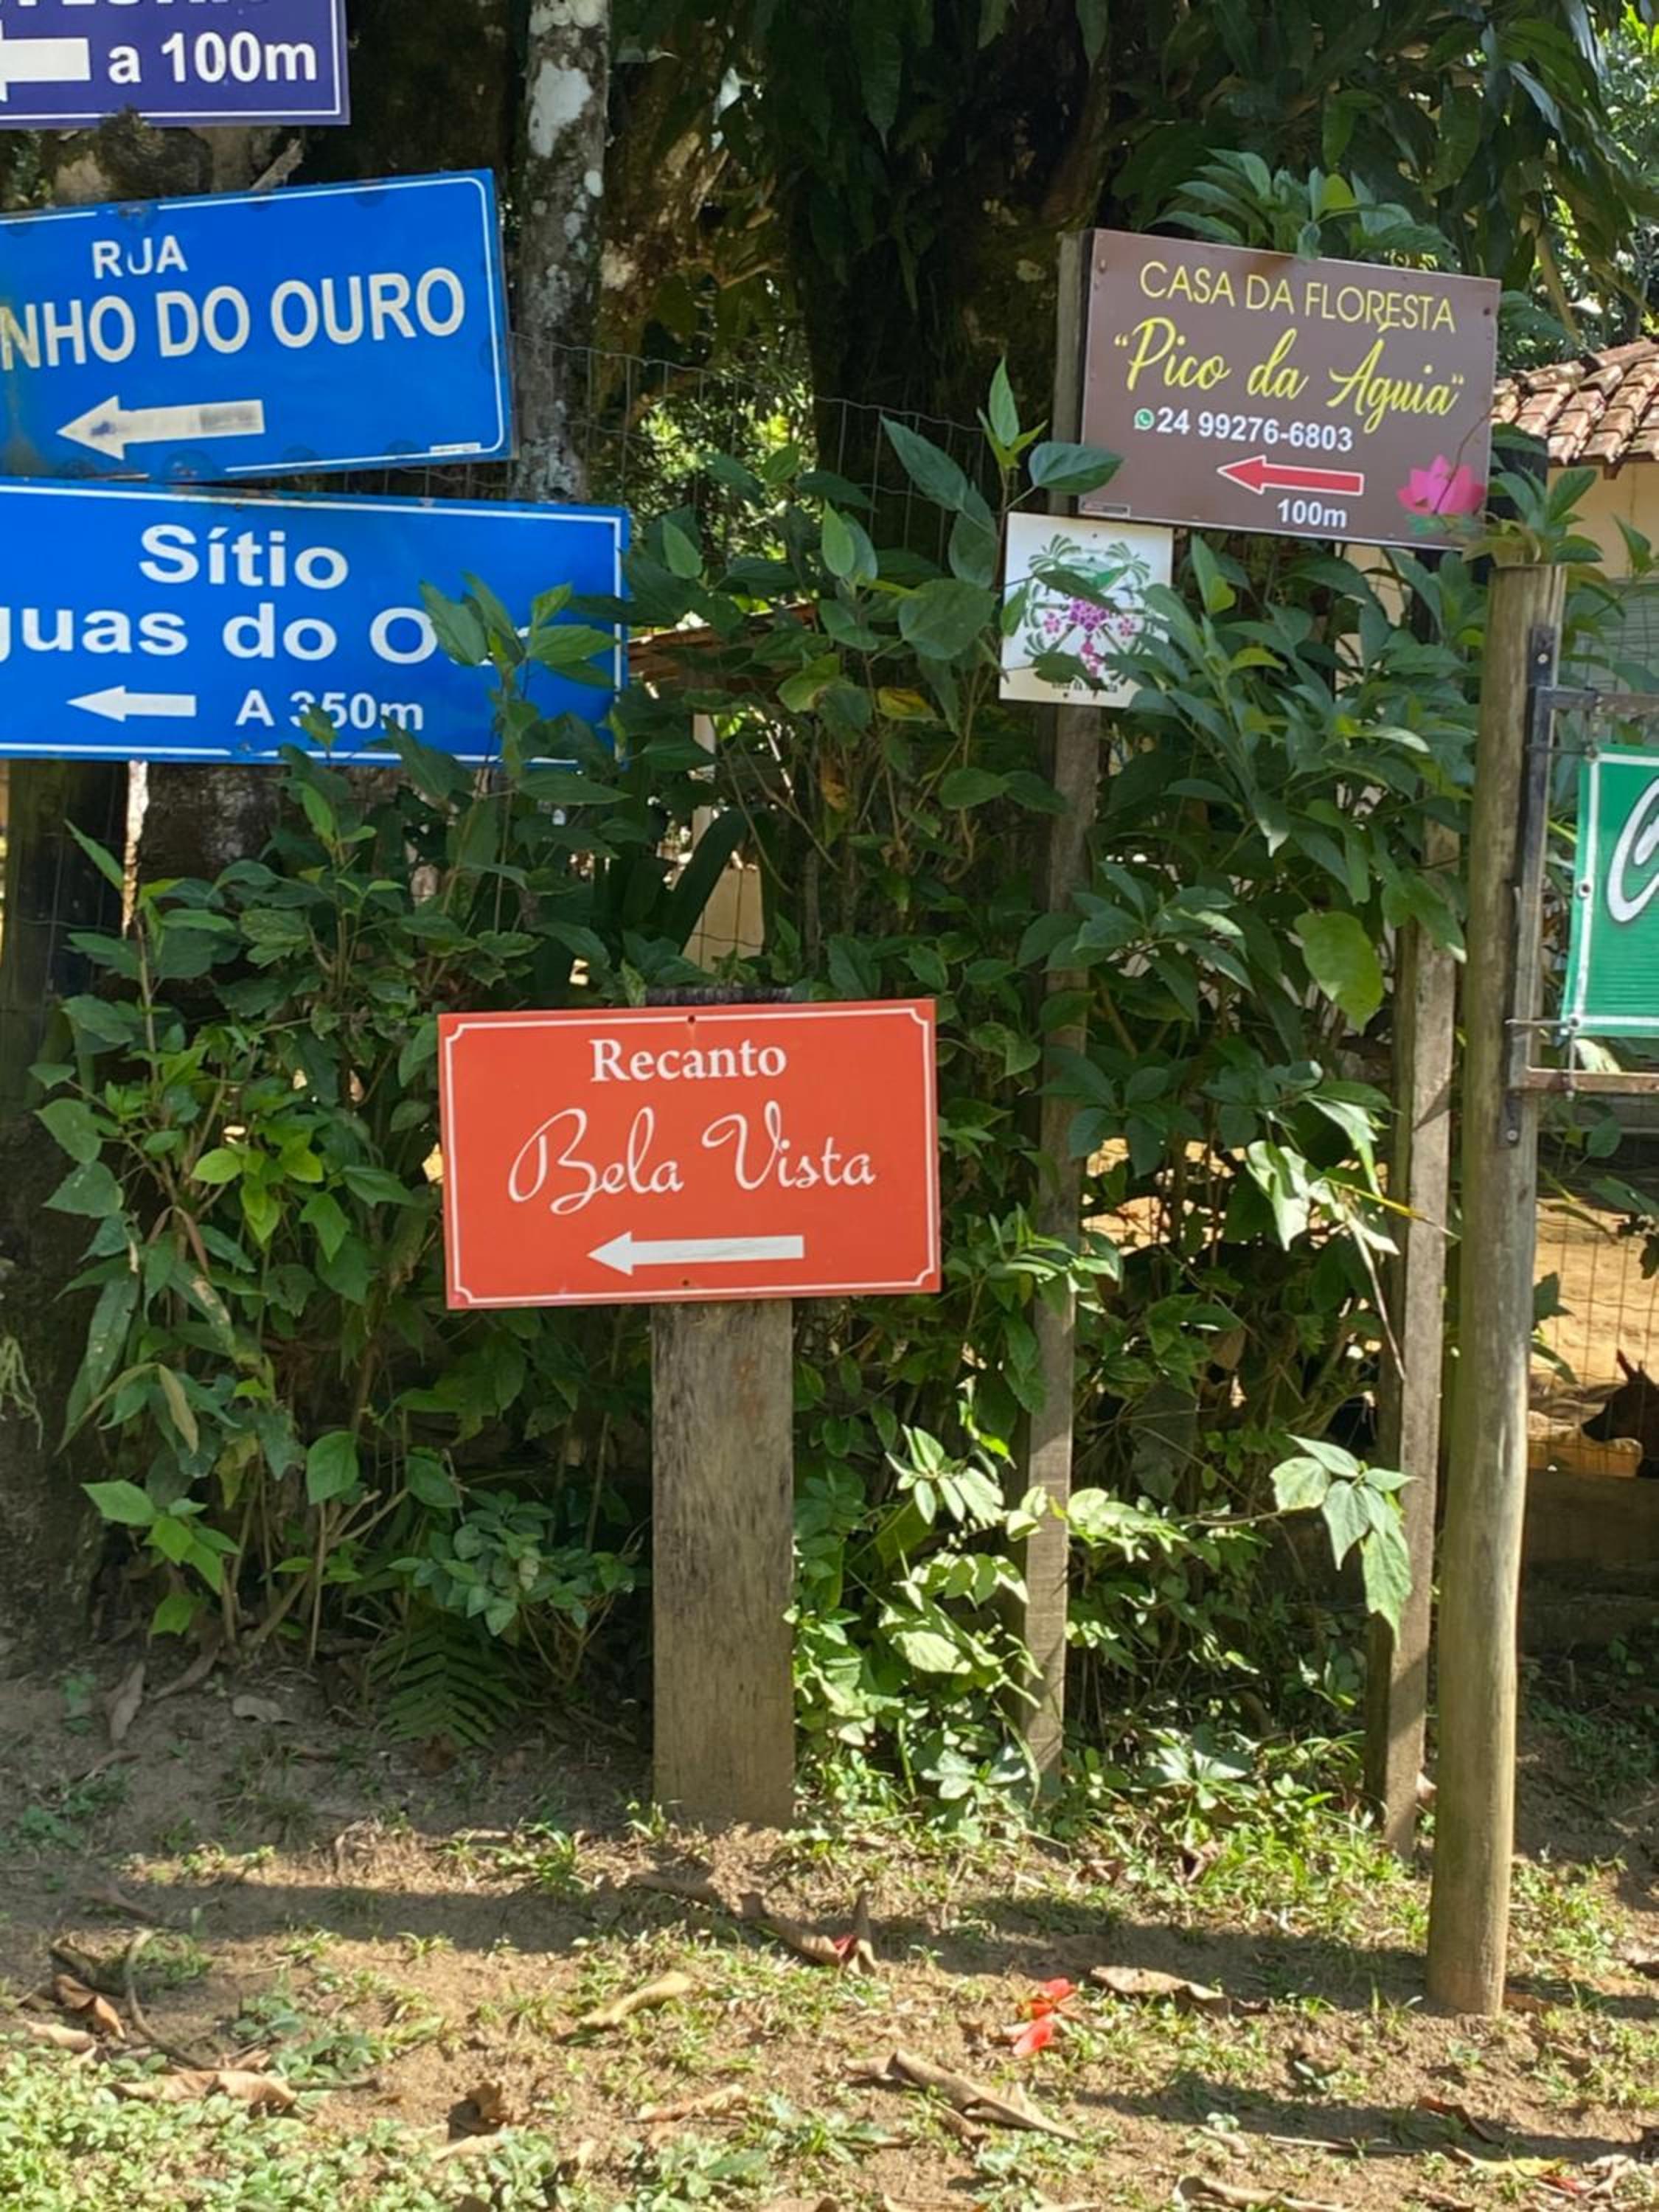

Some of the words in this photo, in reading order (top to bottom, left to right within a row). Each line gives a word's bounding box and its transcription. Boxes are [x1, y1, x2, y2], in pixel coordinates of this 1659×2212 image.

[108, 45, 141, 83] a
[161, 32, 316, 83] 100m
[156, 286, 250, 358] DO
[271, 268, 465, 348] OURO
[1140, 261, 1235, 307] CASA
[1246, 275, 1295, 315] DA
[1305, 282, 1456, 333] FLORESTA
[1246, 328, 1309, 400] da
[1156, 407, 1190, 435] 24
[1198, 411, 1354, 452] 99276-6803
[1277, 498, 1347, 529] 100m
[139, 524, 349, 589] Sítio
[222, 602, 337, 661] do
[235, 691, 274, 726] A
[589, 1038, 786, 1082] Recanto
[507, 1106, 684, 1215] Bela
[701, 1100, 876, 1190] Vista
